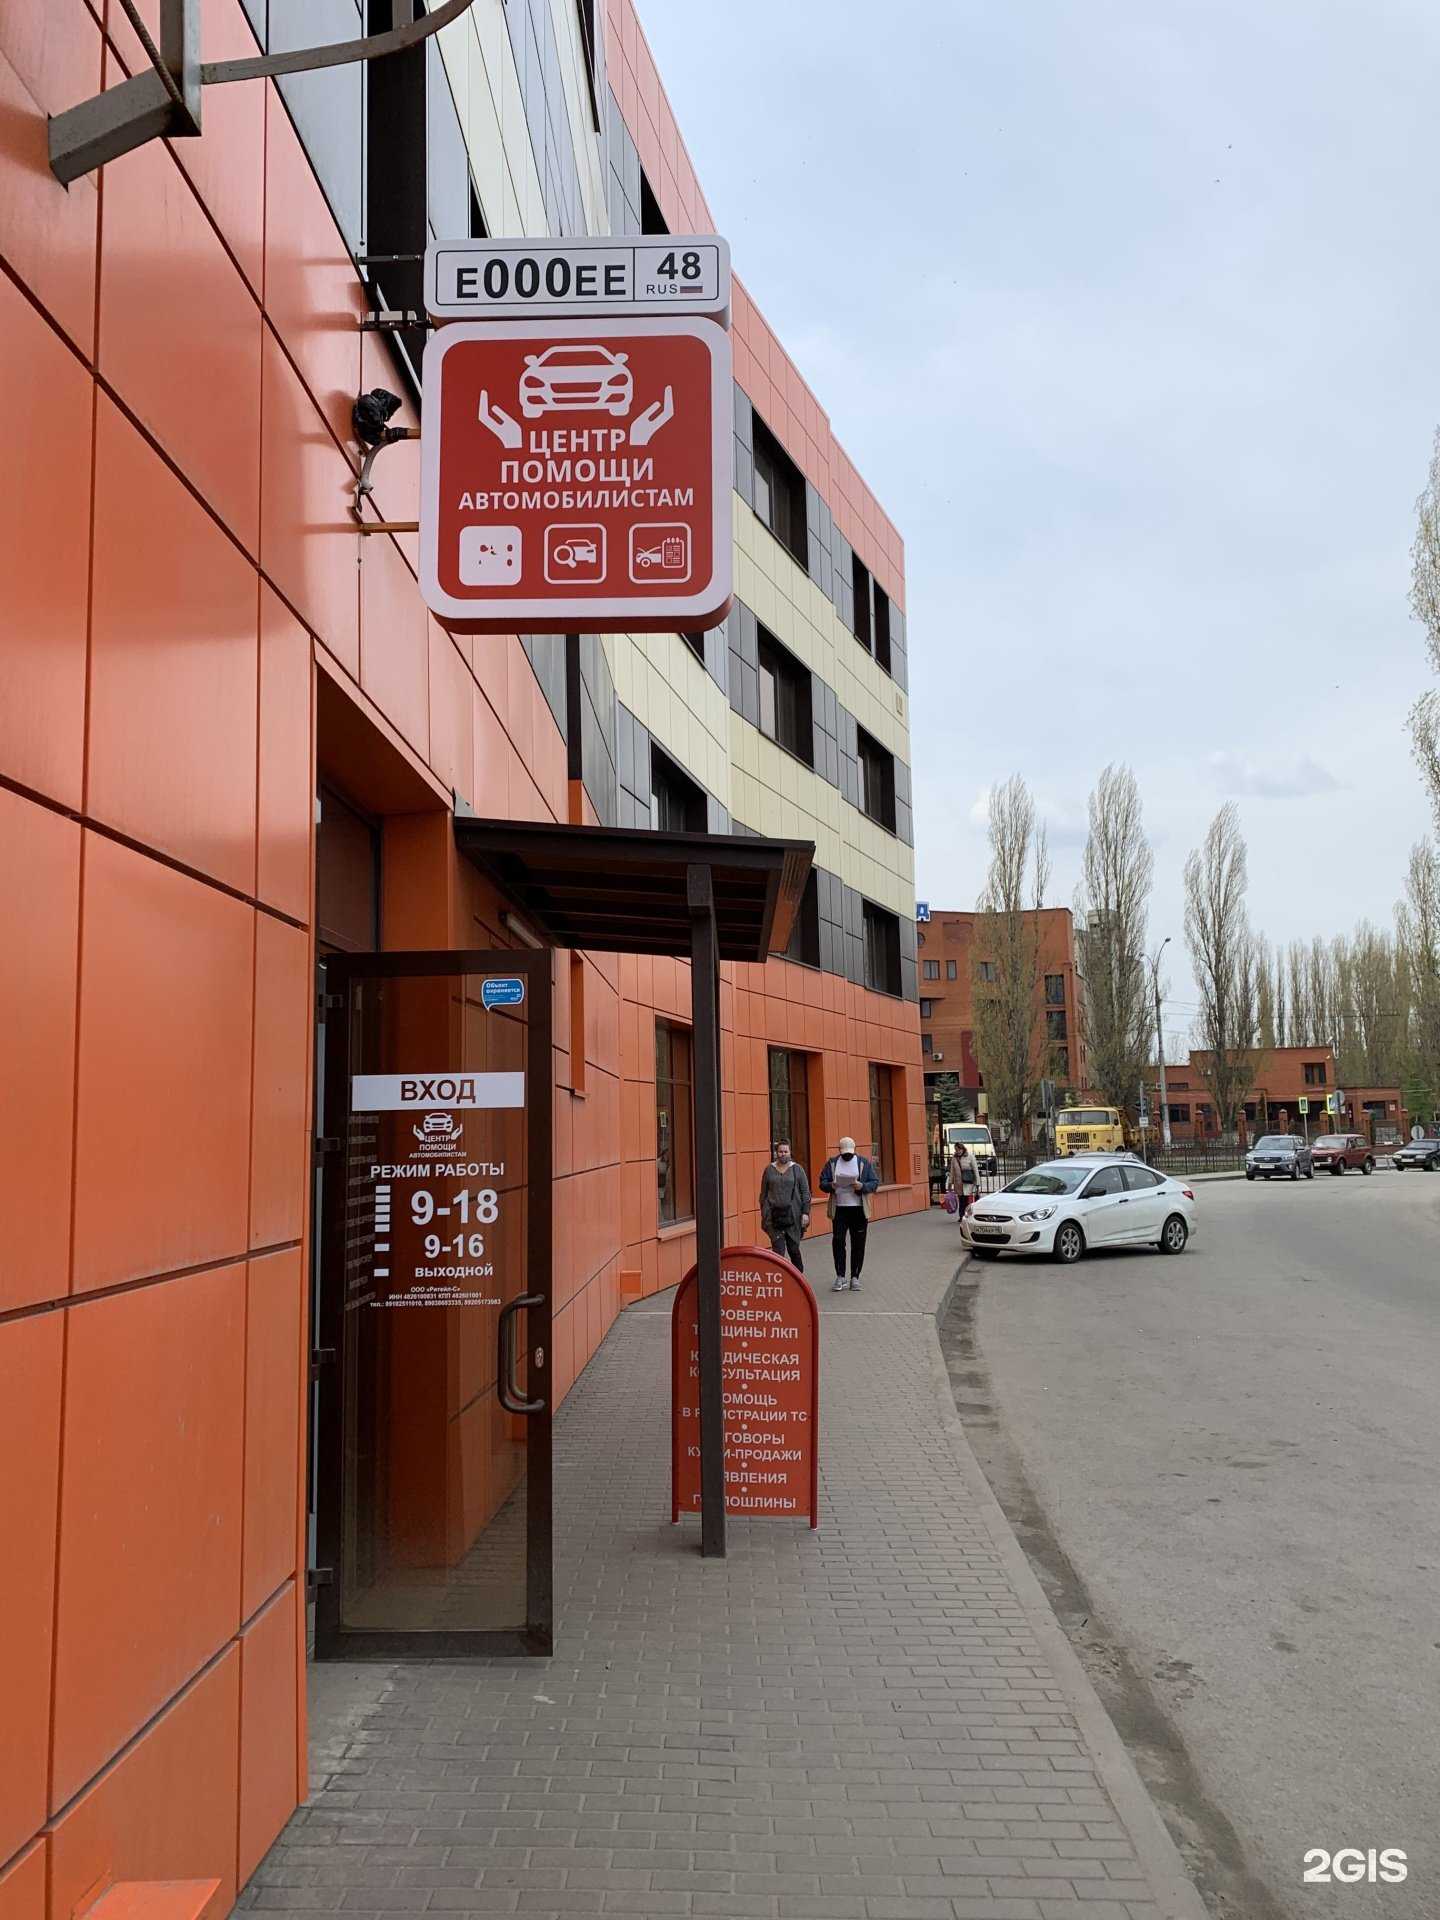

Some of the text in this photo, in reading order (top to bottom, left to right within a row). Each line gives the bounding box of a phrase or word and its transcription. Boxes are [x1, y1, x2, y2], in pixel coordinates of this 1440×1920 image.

[656, 251, 701, 280] 48
[646, 283, 678, 295] RUS
[529, 429, 627, 458] ЦЕНТР
[500, 457, 654, 486] ПОМОЩИ
[458, 487, 694, 510] АВТОМОБИЛИСТАМ
[400, 1079, 476, 1104] ВХОД
[424, 1134, 452, 1143] ЦЕНТР
[418, 1143, 457, 1152] ПОМОЩИ
[370, 1162, 505, 1178] РЕЖИМ РАБОТЫ
[410, 1188, 499, 1225] 9-18
[424, 1233, 485, 1259] 9-16
[720, 1271, 783, 1284] ЦЕНКА ТС
[720, 1285, 783, 1299] ОСЛЕ ДТП
[720, 1308, 783, 1322] РОВЕРКА
[692, 1323, 799, 1339] ТЩИНЫ ЛКП
[689, 1366, 801, 1382] КСУЛЬТАЦИЯ
[722, 1392, 778, 1406] ОМОЩЬ
[682, 1407, 691, 1418] В
[791, 1411, 808, 1422] ТС
[724, 1432, 785, 1445] ГОВОРЫ
[724, 1472, 787, 1484] ЯВЛЕНИЯ
